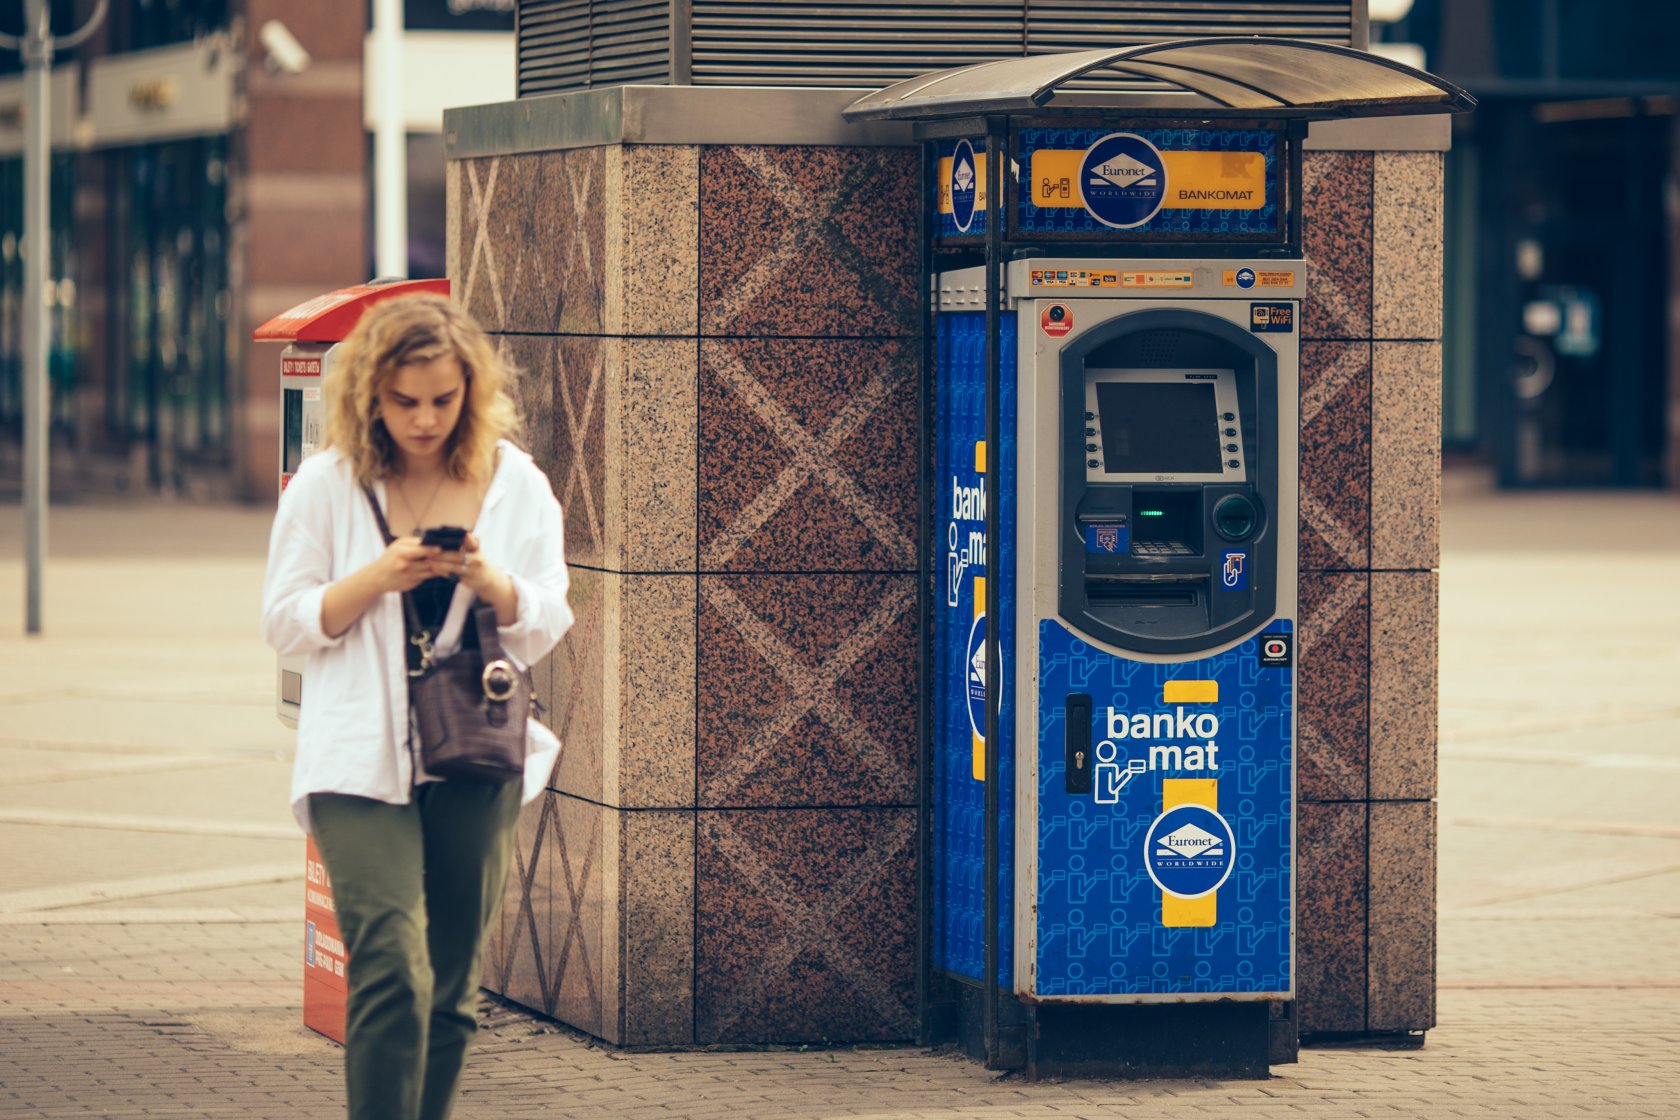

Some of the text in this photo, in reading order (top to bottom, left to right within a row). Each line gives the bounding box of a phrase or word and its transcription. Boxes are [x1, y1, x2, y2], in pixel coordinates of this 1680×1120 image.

[1102, 164, 1146, 176] Euronet
[1178, 190, 1254, 201] BANKOMAT
[1270, 306, 1291, 316] Free
[1271, 315, 1291, 325] WiFi
[953, 475, 986, 521] bank
[1107, 706, 1219, 739] banko
[1148, 740, 1219, 771] mat
[1167, 835, 1212, 847] Euronet
